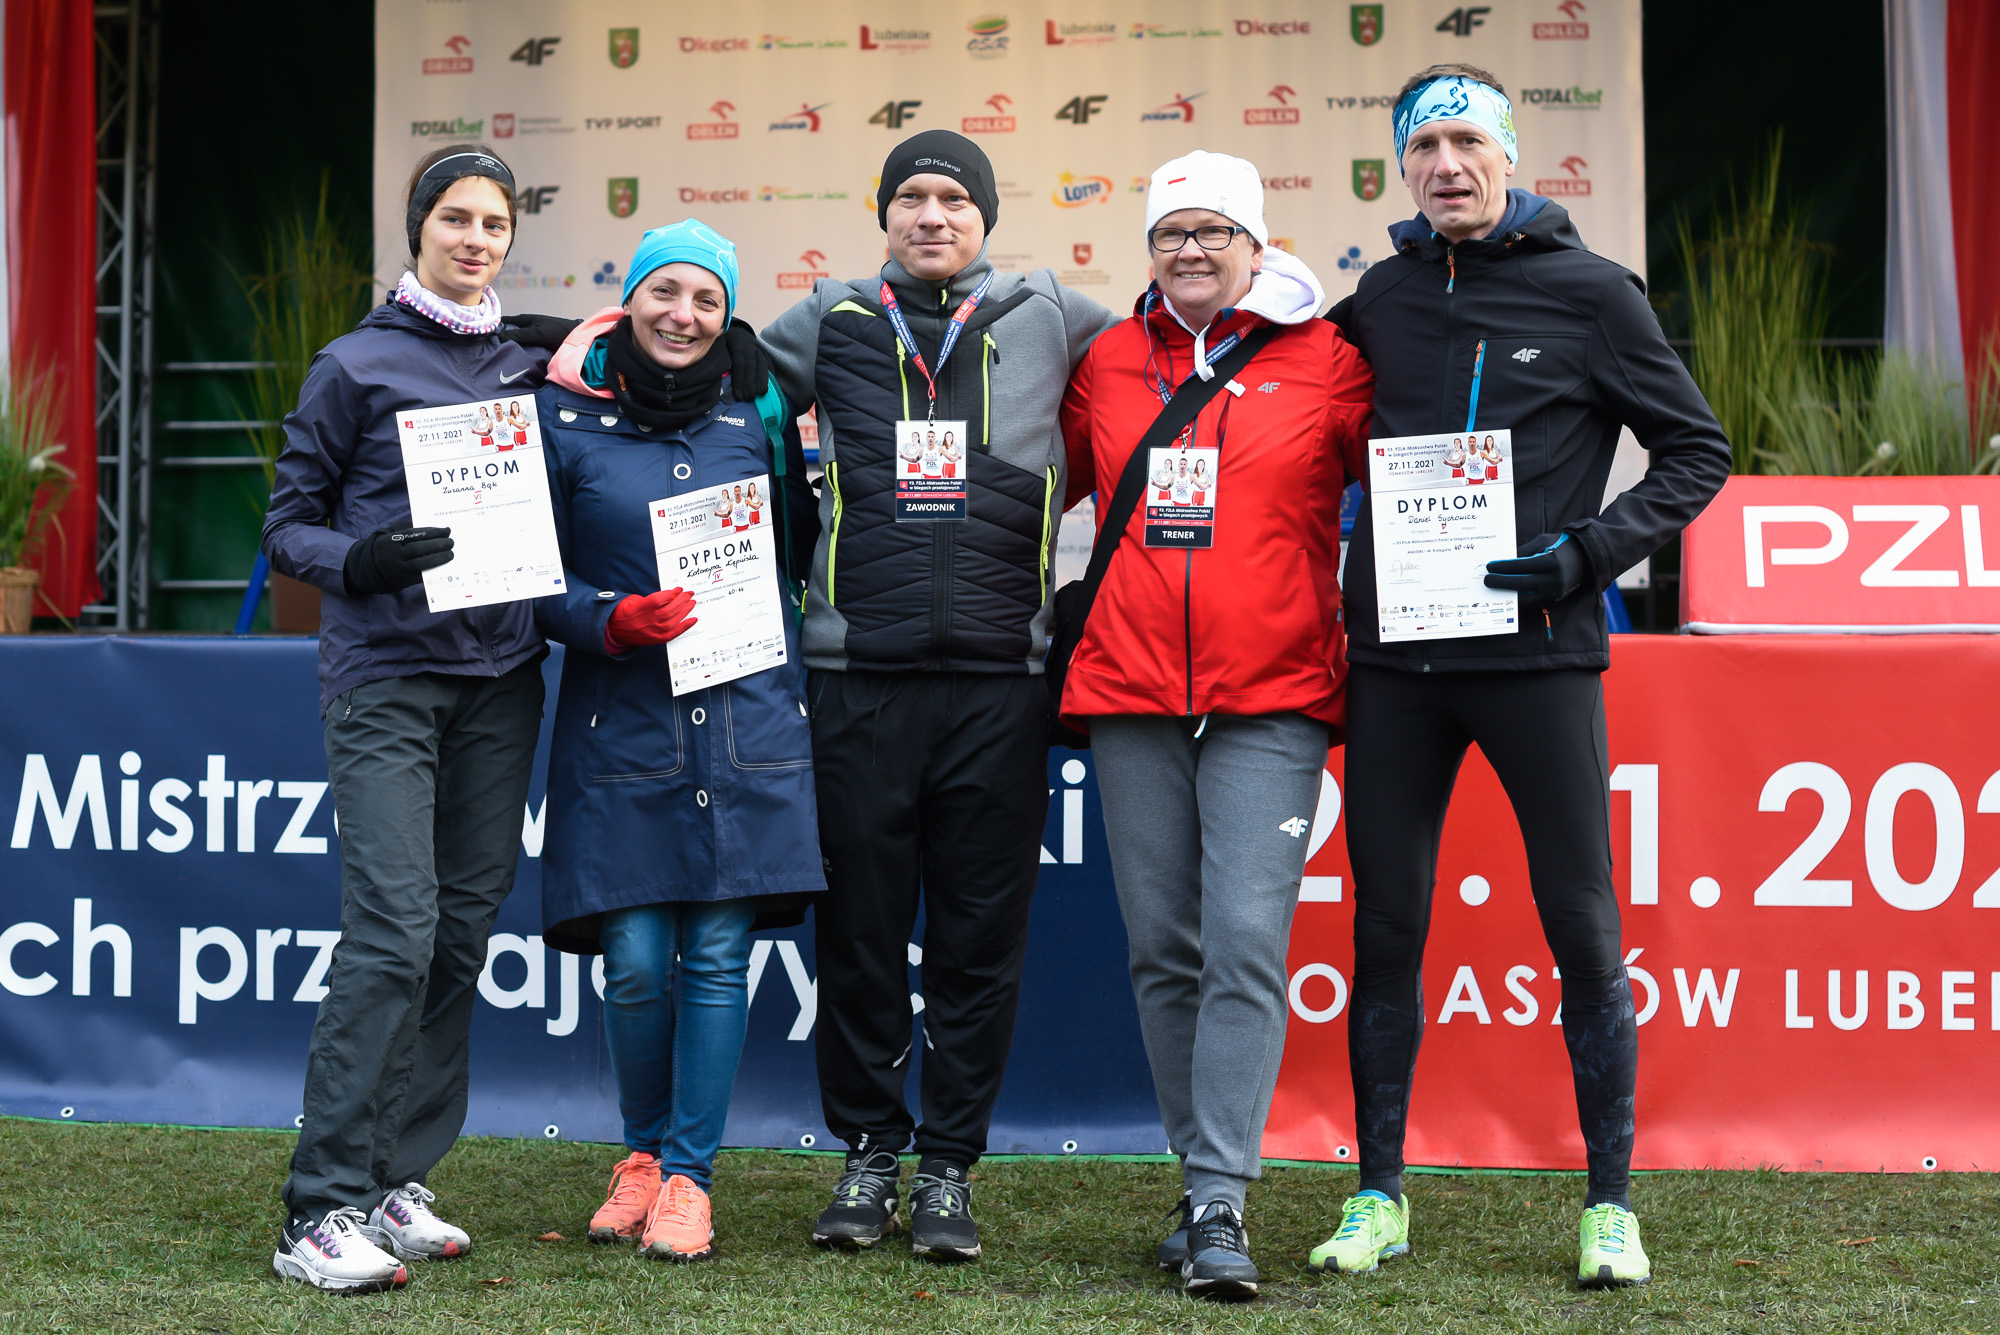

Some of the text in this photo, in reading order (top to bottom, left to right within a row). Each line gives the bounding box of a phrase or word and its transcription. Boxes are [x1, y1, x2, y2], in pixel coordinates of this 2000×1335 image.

[1435, 7, 1491, 36] 4F
[509, 36, 562, 66] 4F
[1055, 95, 1108, 124] 4F
[1326, 97, 1357, 110] TVP
[868, 100, 922, 130] 4F
[585, 118, 613, 130] TVP
[617, 116, 662, 129] SPORT
[1512, 348, 1541, 362] 4F
[1257, 382, 1281, 394] 4F
[418, 429, 463, 442] 27.11.2021
[431, 459, 520, 485] DYPLOM
[1388, 460, 1434, 470] 27.11.2021
[906, 503, 955, 511] ZAWODNIK
[1397, 494, 1487, 513] DYPLOM
[670, 513, 707, 529] 27.11.2021
[1408, 516, 1431, 524] Daniel
[1162, 531, 1194, 539] TRENER
[679, 539, 752, 570] DYPLOM
[1279, 816, 1309, 838] 4F
